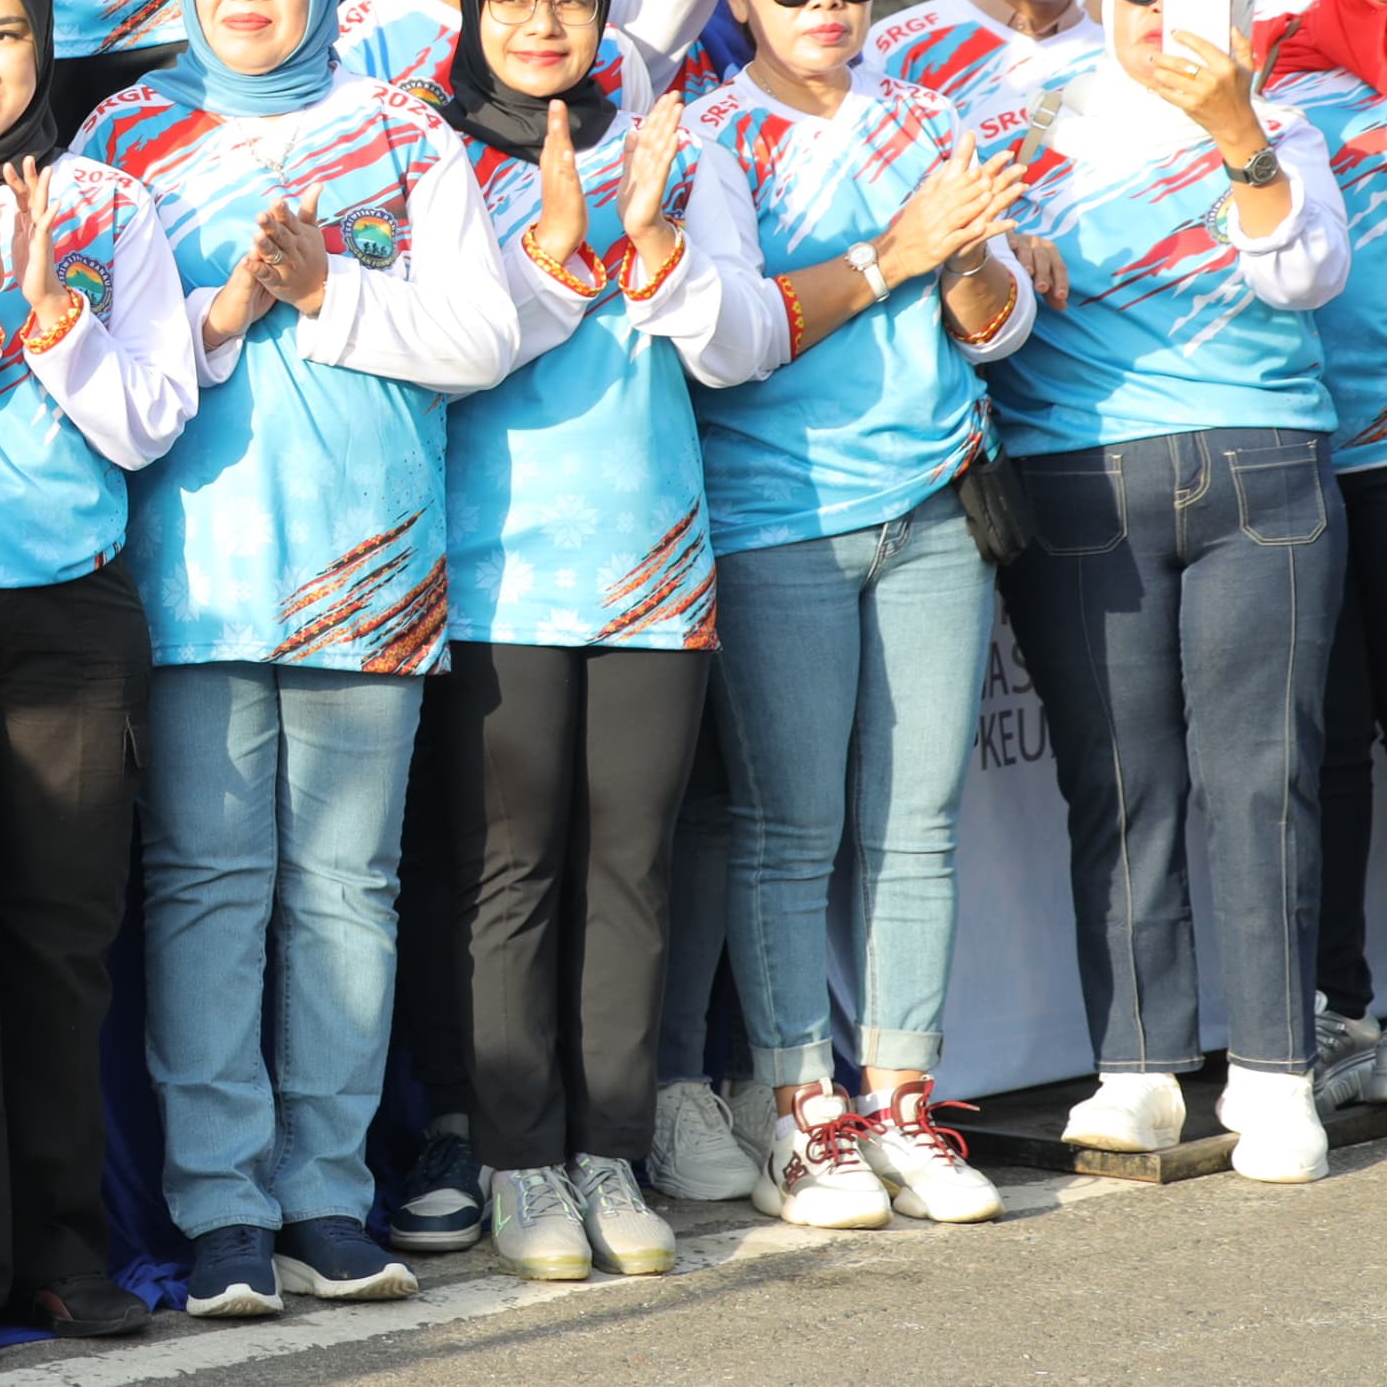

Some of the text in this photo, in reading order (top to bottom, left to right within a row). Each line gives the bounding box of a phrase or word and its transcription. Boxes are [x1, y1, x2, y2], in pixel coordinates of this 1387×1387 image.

[876, 12, 939, 54] SRGF
[372, 85, 443, 130] 2024
[980, 108, 1028, 139] SR
[74, 168, 133, 189] 2024
[982, 641, 1033, 699] AS
